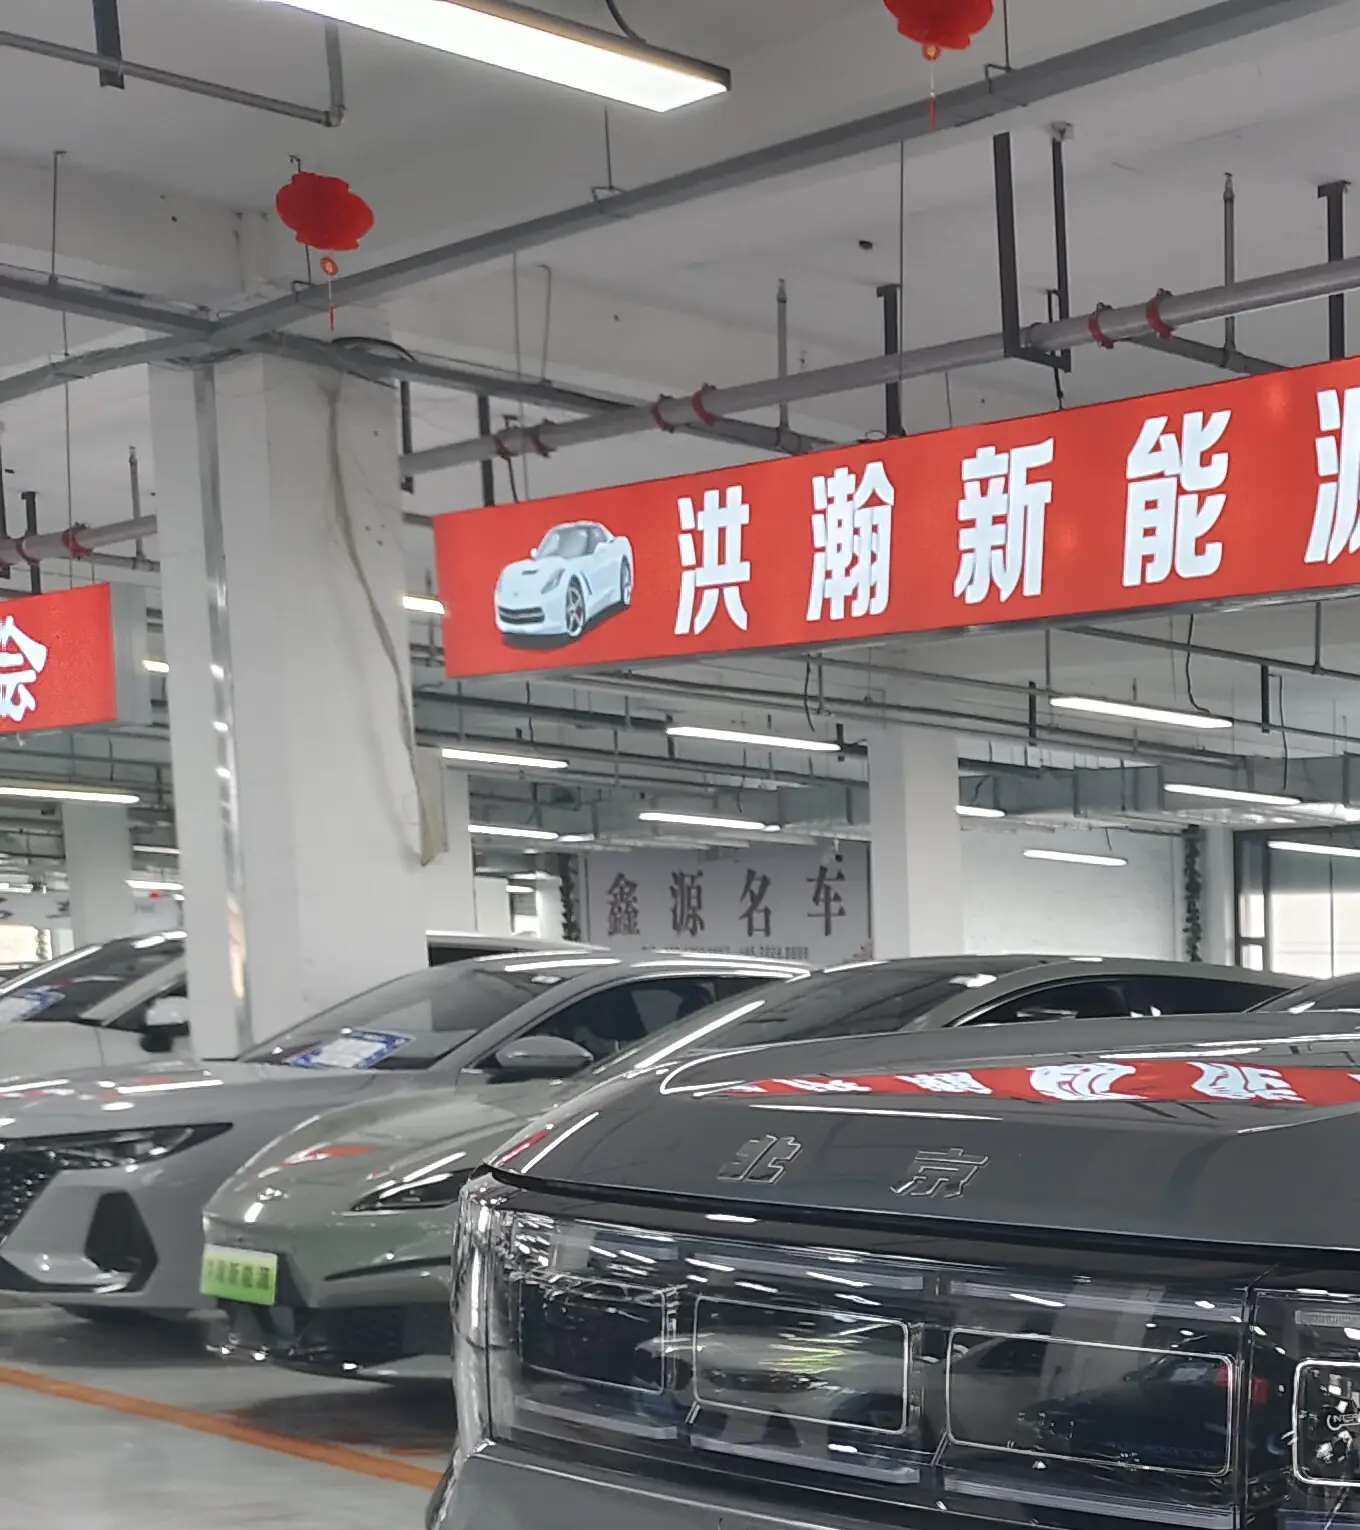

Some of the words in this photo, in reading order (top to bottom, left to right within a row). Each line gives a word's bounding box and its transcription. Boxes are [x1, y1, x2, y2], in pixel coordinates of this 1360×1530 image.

[607, 864, 847, 937] 鑫源名车
[716, 1134, 989, 1198] 北京
